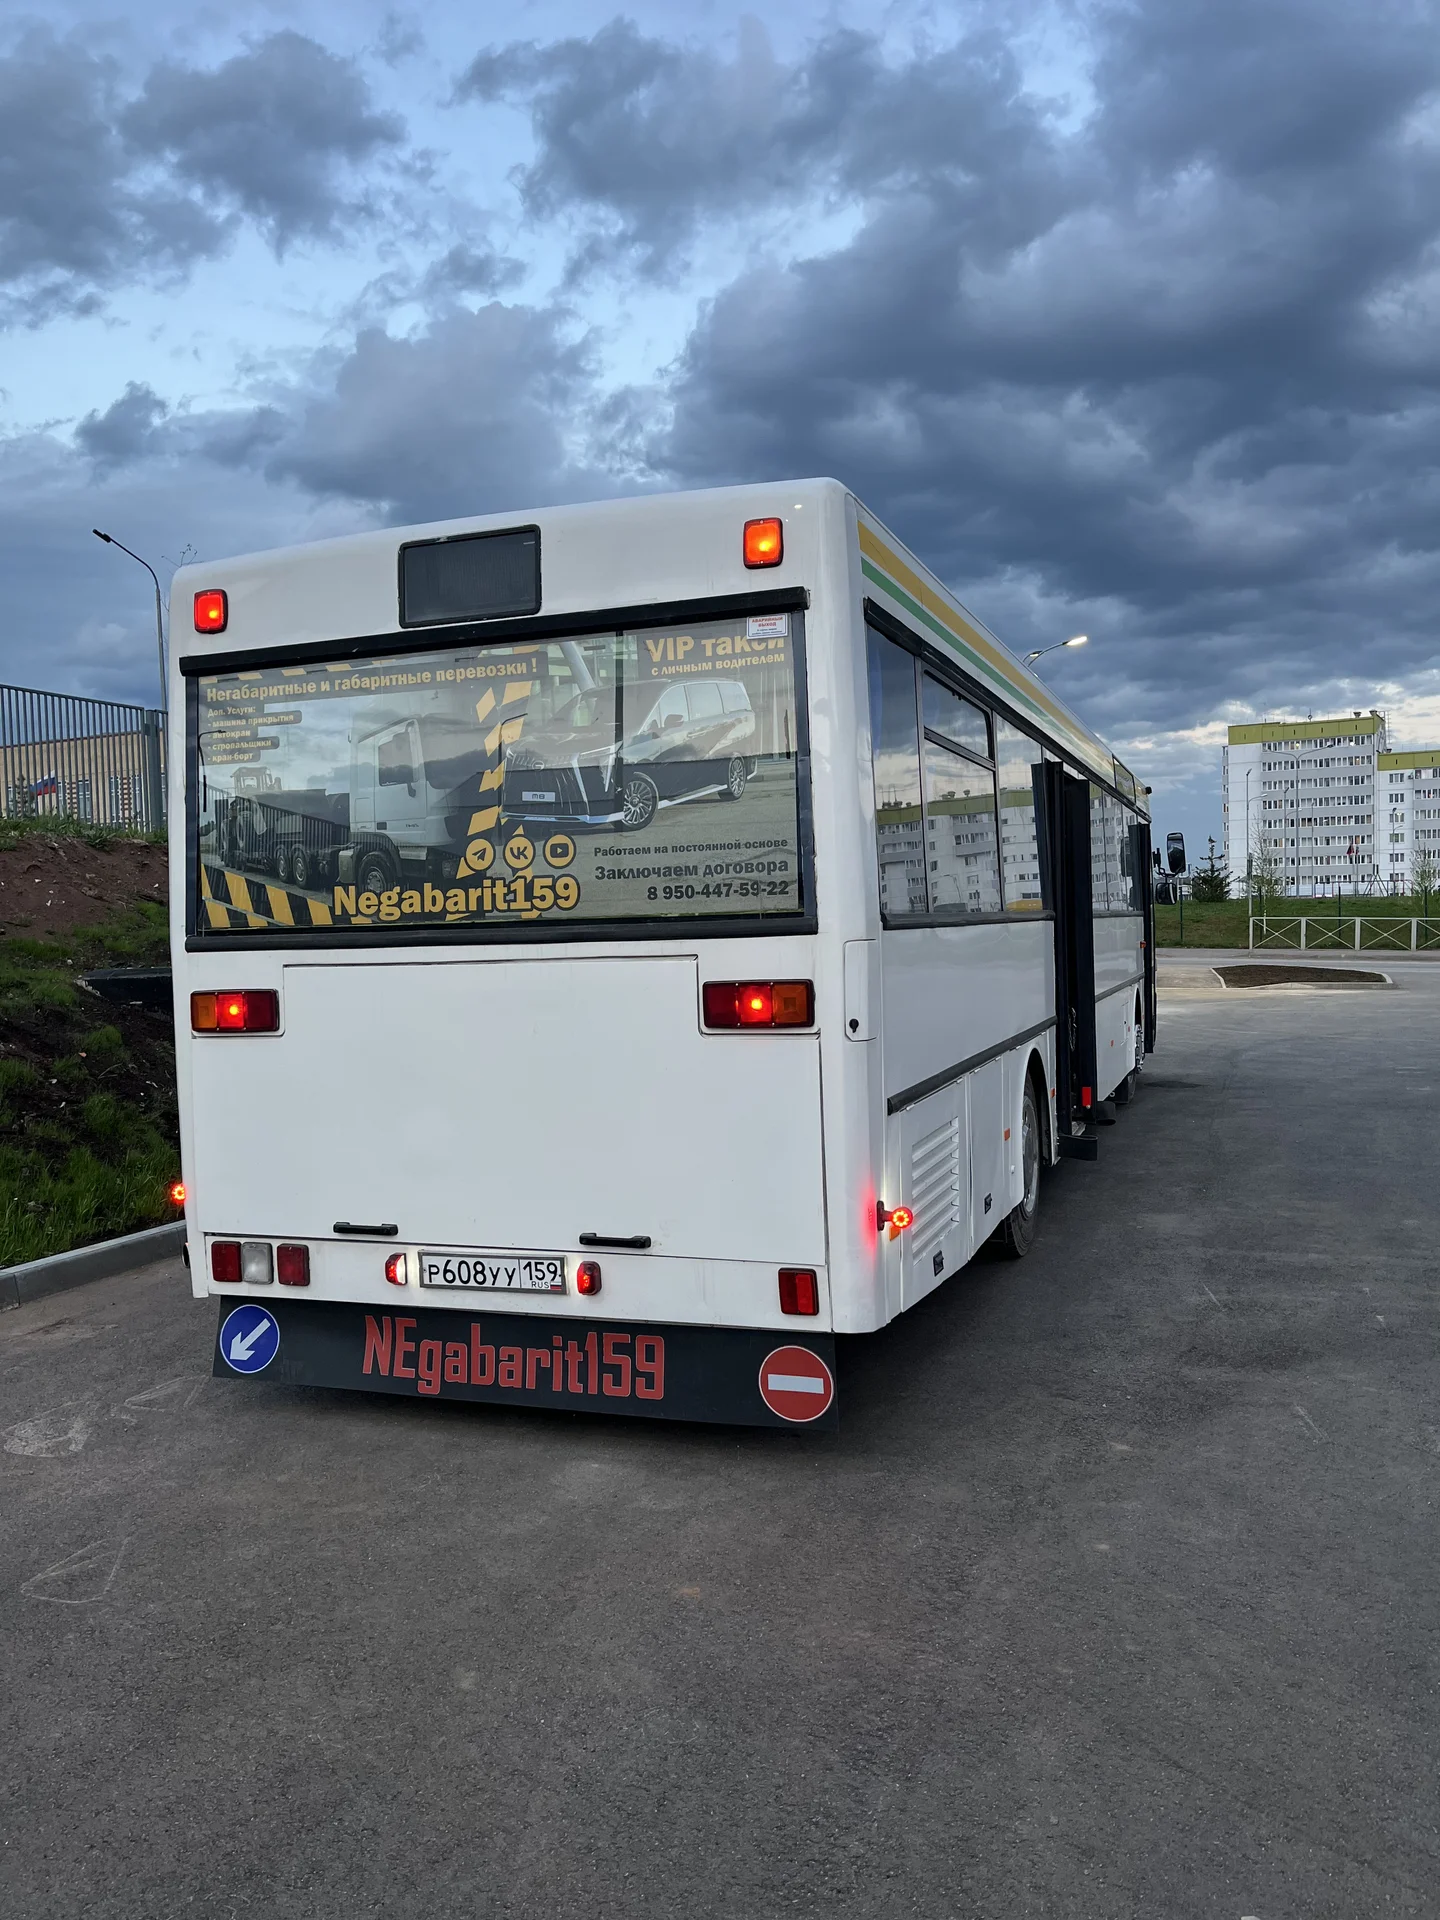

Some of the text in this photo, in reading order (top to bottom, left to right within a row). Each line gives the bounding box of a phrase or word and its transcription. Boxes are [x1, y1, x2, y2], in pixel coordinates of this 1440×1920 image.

[645, 635, 785, 662] VIP такси
[651, 653, 785, 676] с личным водителем
[207, 682, 317, 702] Негабаритные
[320, 680, 330, 691] и
[335, 671, 431, 691] габаритные
[436, 662, 527, 683] перевозки
[207, 706, 257, 718] Доп. Услуги:
[212, 714, 294, 728] машина прикрытия
[212, 729, 251, 739] автокран
[212, 740, 272, 751] стропальщики
[212, 752, 254, 763] кран-борт
[594, 839, 788, 857] Работаем на постоянной основе
[594, 860, 789, 881] Заключаем договора
[333, 876, 579, 921] Negabarit159
[646, 880, 789, 900] 8 950-447-59-22
[522, 1261, 558, 1281] 159
[531, 1280, 550, 1289] RUS
[362, 1314, 665, 1400] NEgabarit159
